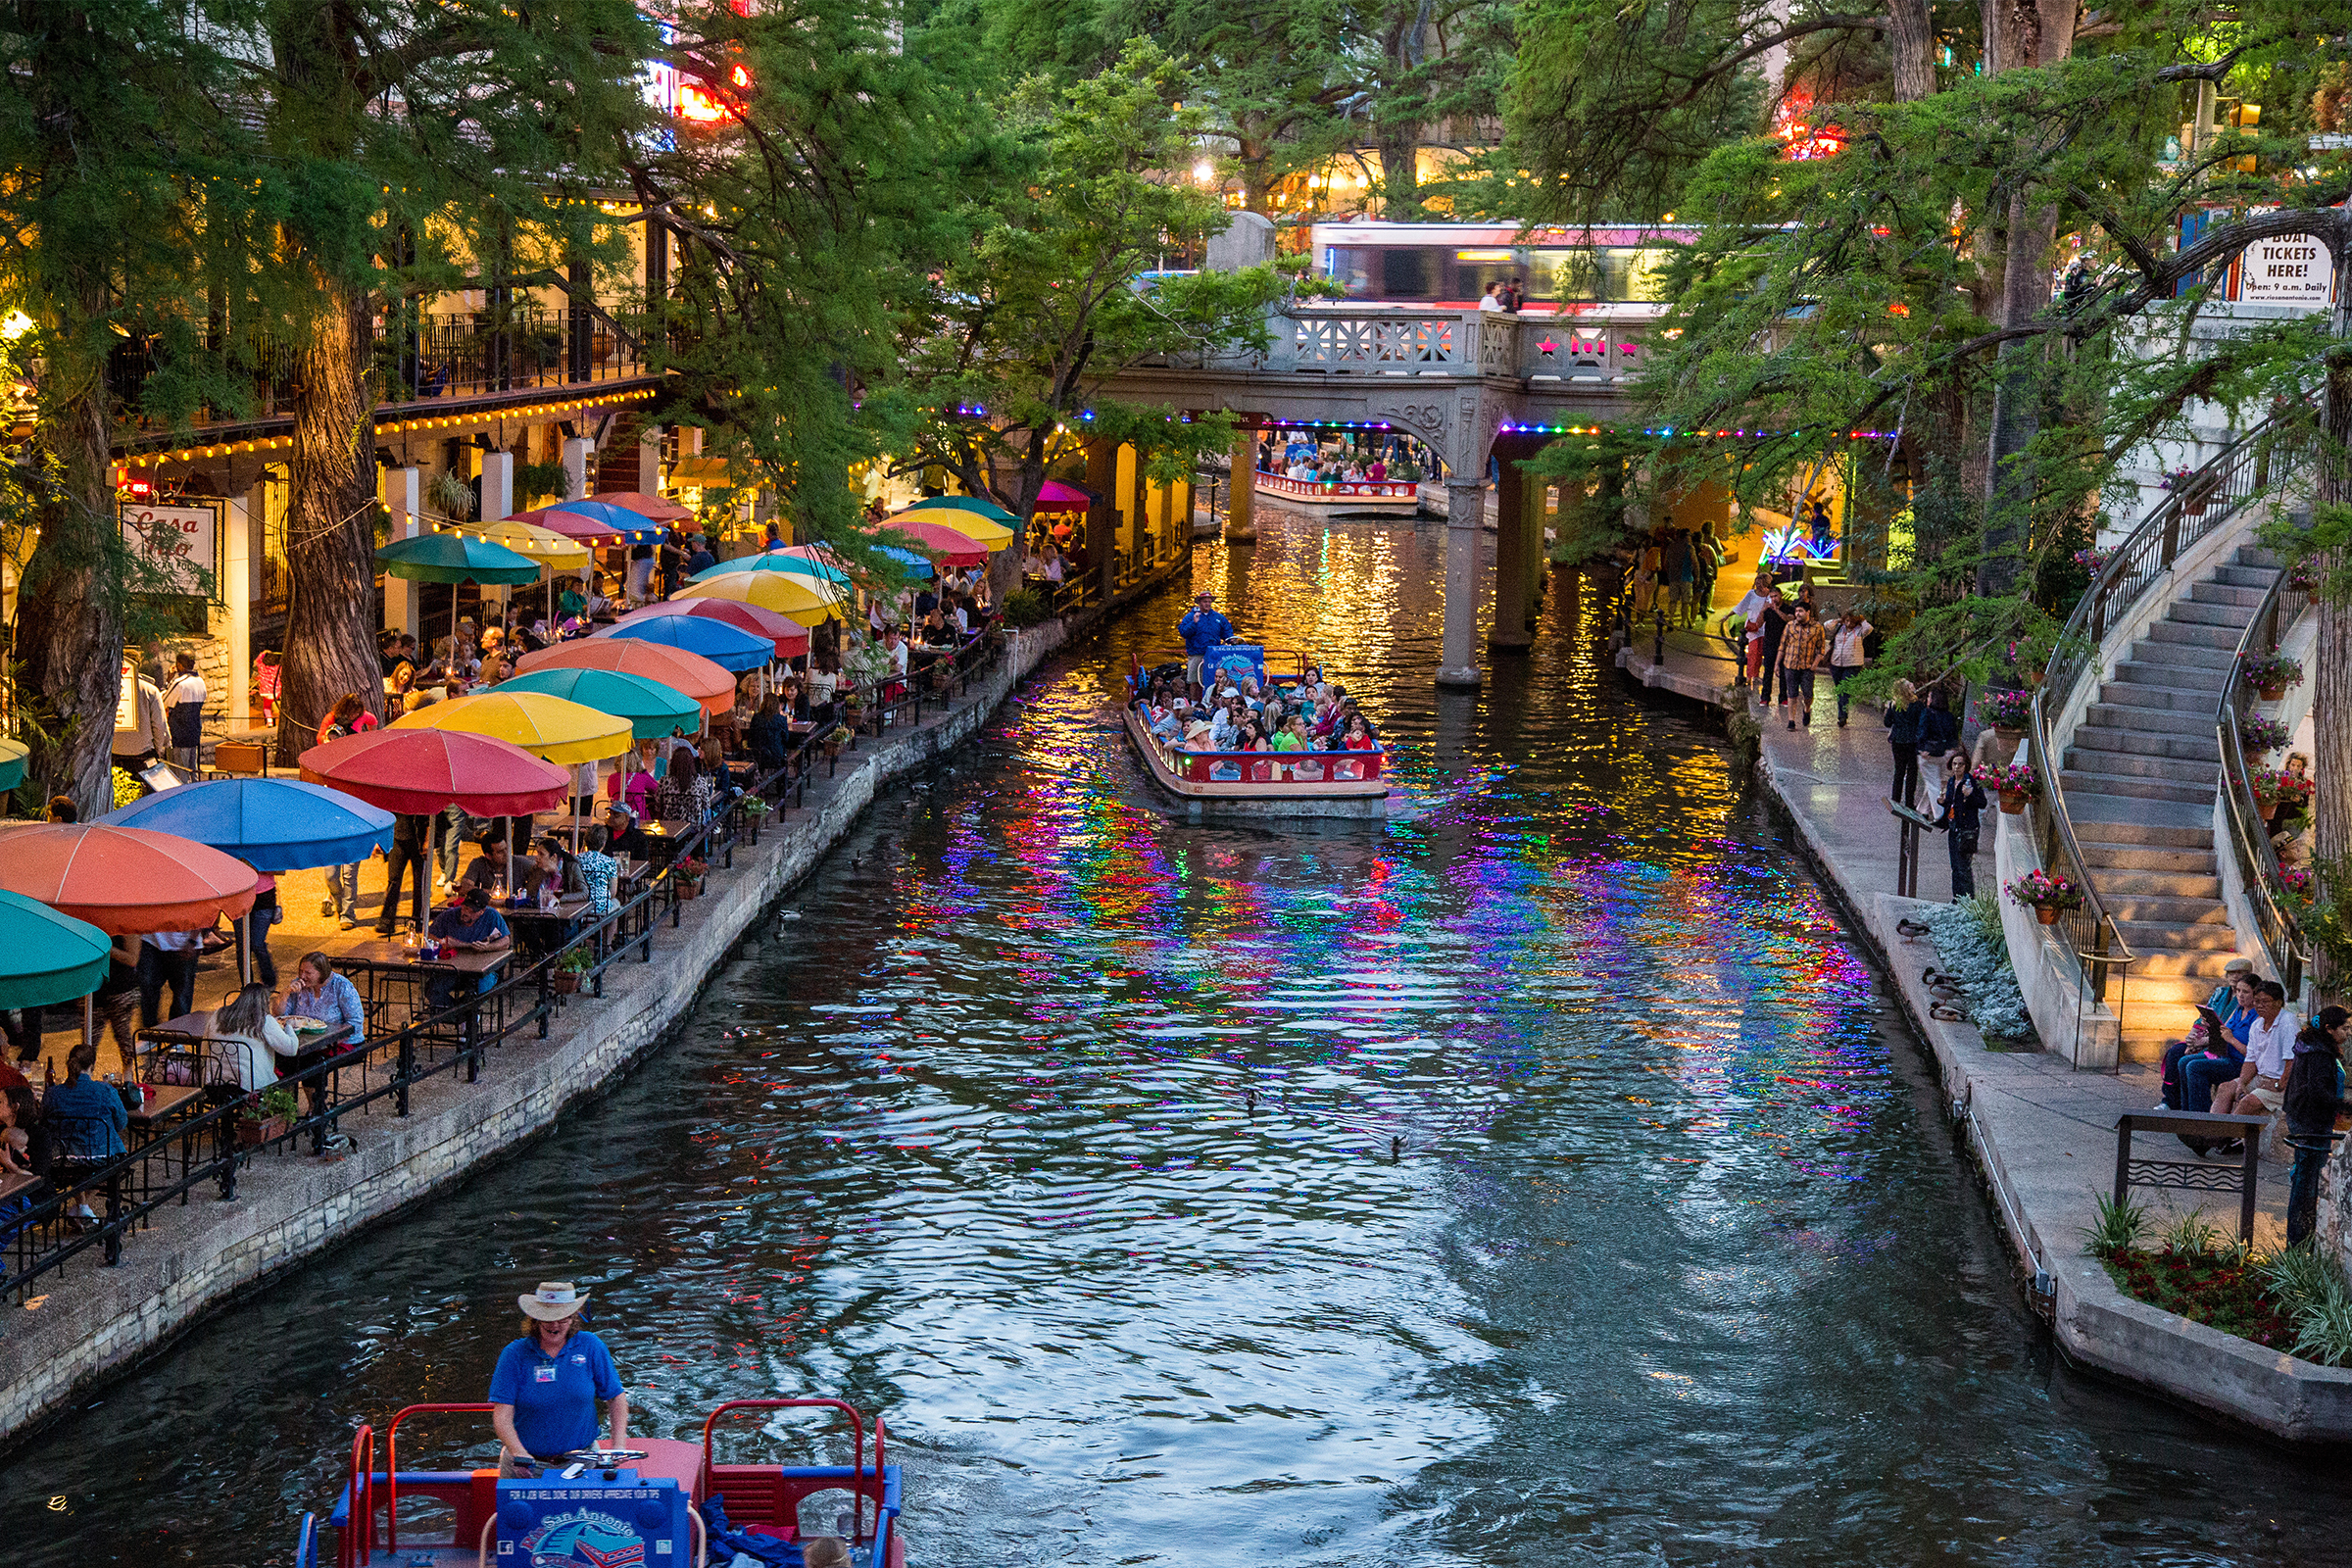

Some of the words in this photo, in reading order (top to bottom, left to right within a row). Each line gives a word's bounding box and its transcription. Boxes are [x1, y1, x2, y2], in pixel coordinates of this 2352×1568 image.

[2263, 247, 2317, 260] TICKETS
[2267, 264, 2309, 277] HERE!
[2245, 282, 2272, 292] Open:
[2274, 282, 2279, 291] 9
[2305, 282, 2328, 293] Daily
[542, 1511, 572, 1529] San
[576, 1505, 636, 1538] Antonio
